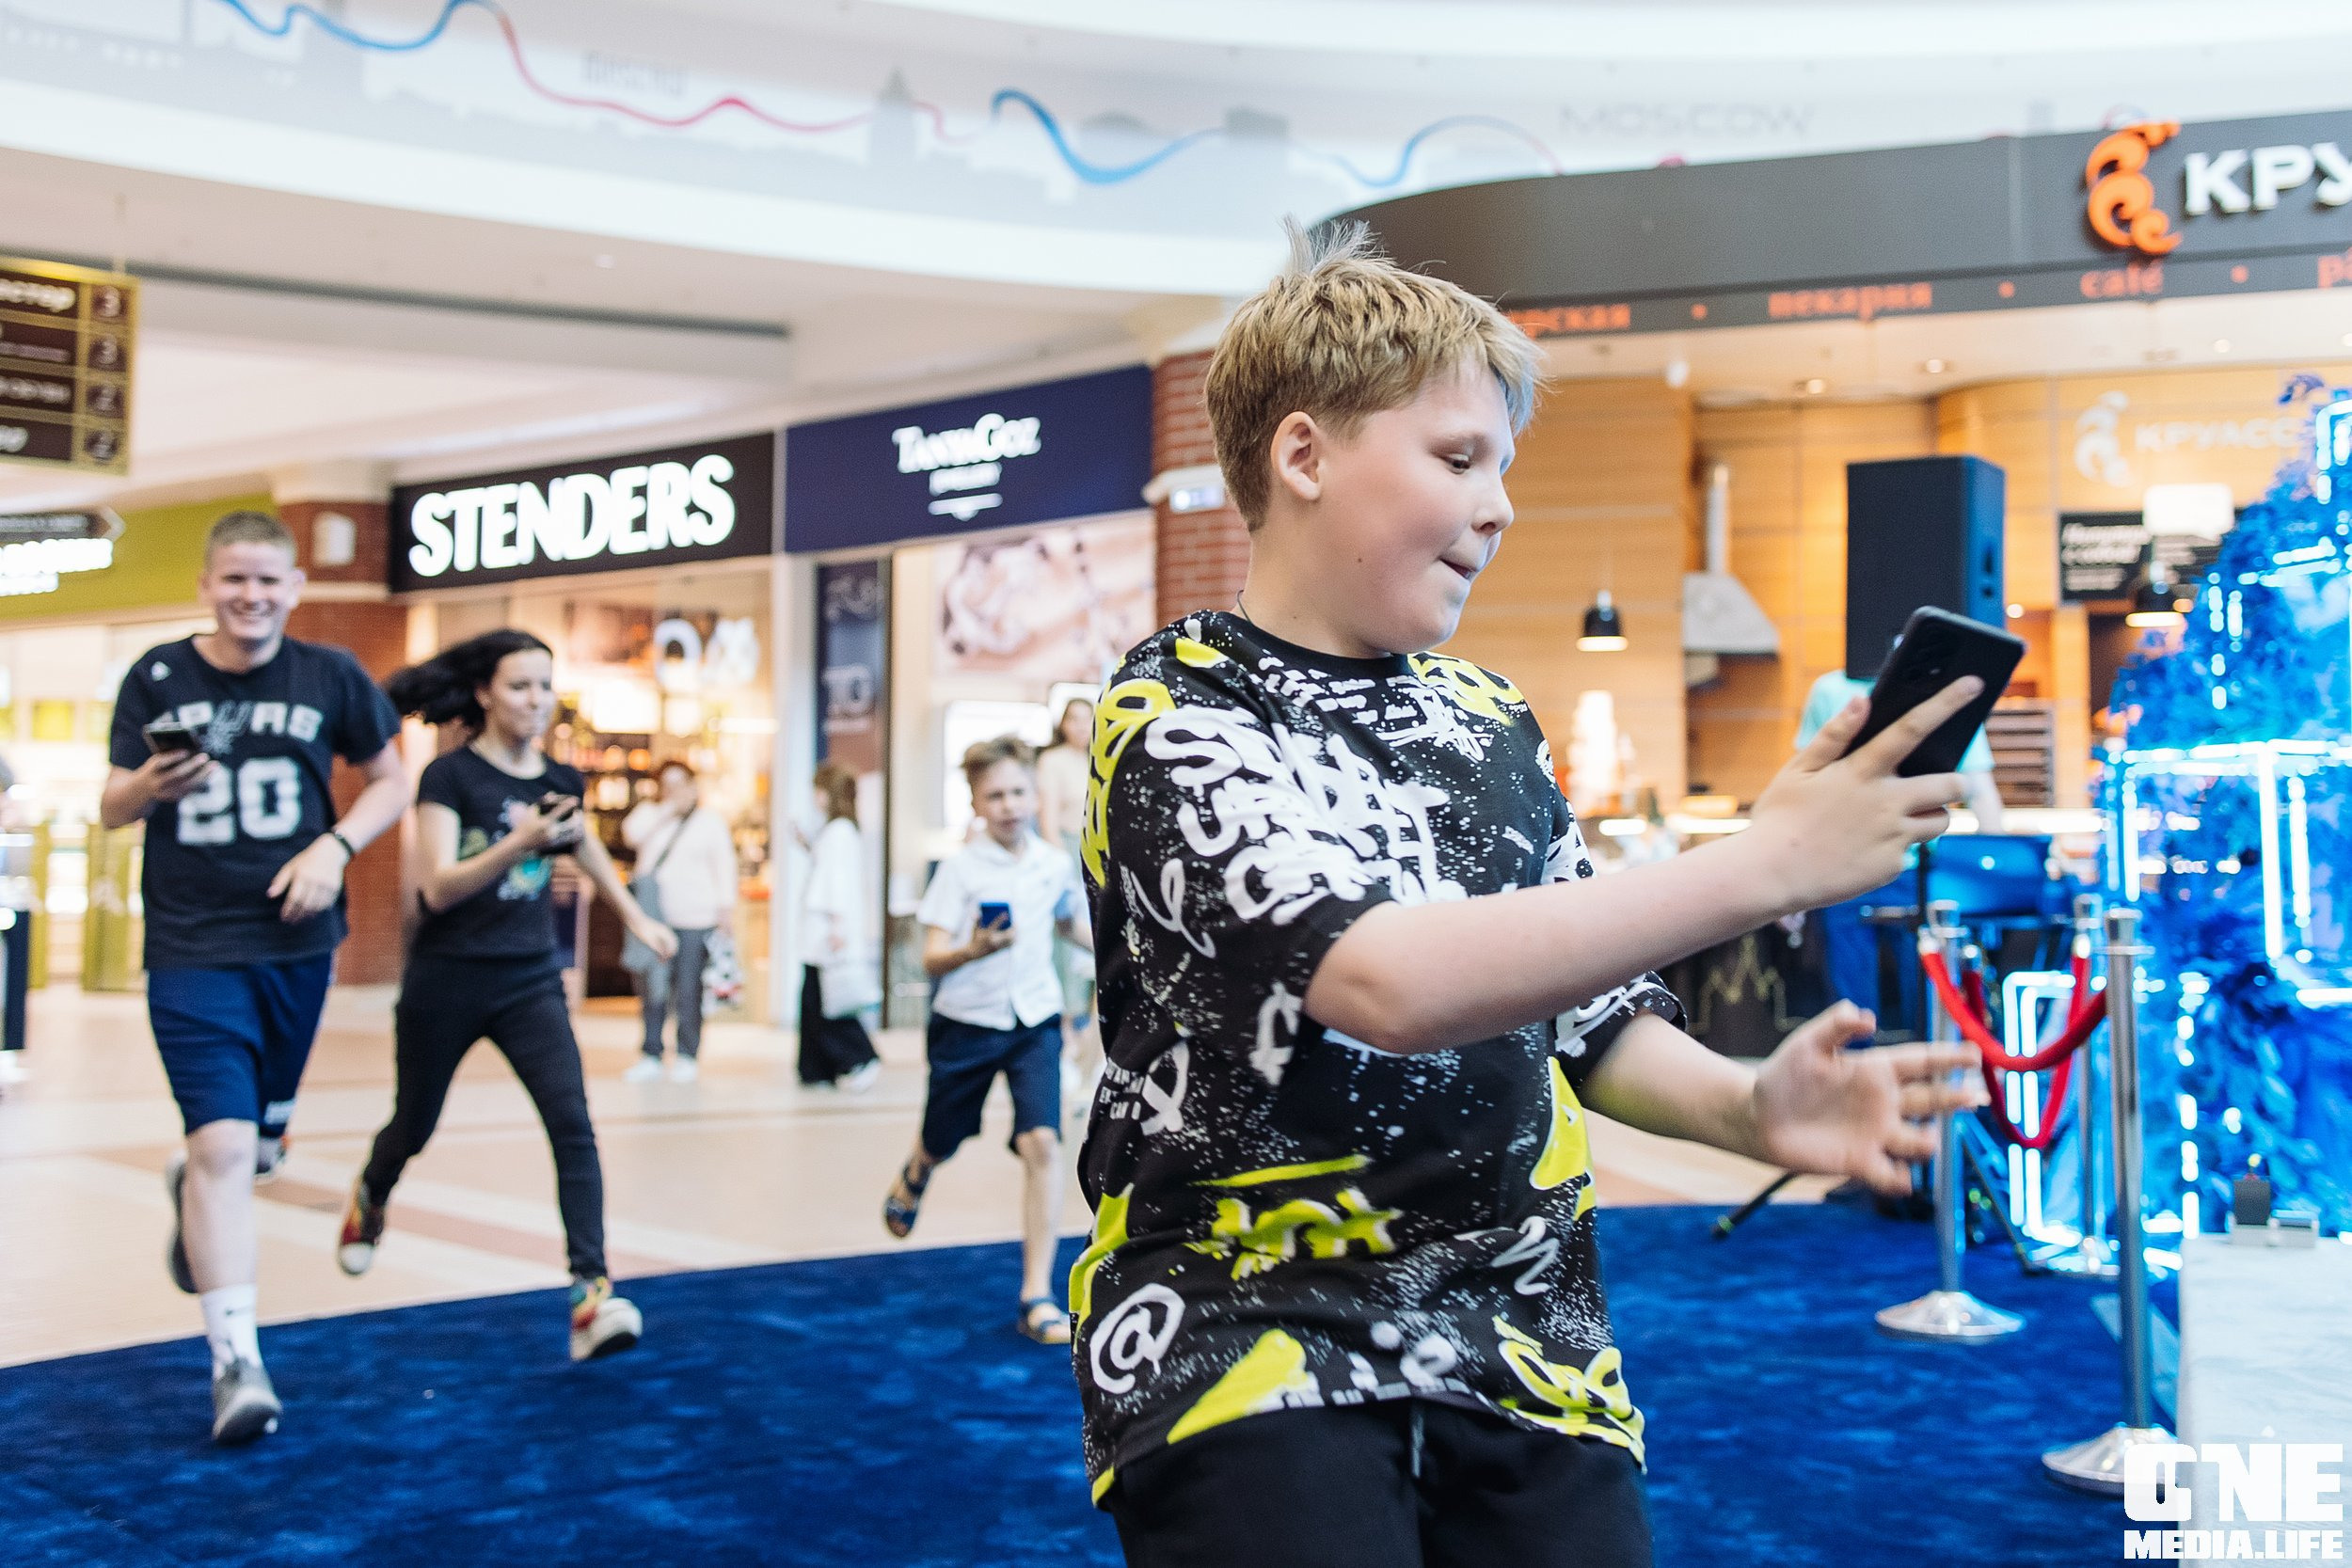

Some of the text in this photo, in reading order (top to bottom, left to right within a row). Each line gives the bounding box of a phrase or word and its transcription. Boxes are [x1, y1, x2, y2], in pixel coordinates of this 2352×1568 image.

[408, 453, 736, 577] STENDERS
[152, 700, 324, 752] PURS
[177, 756, 303, 847] 20
